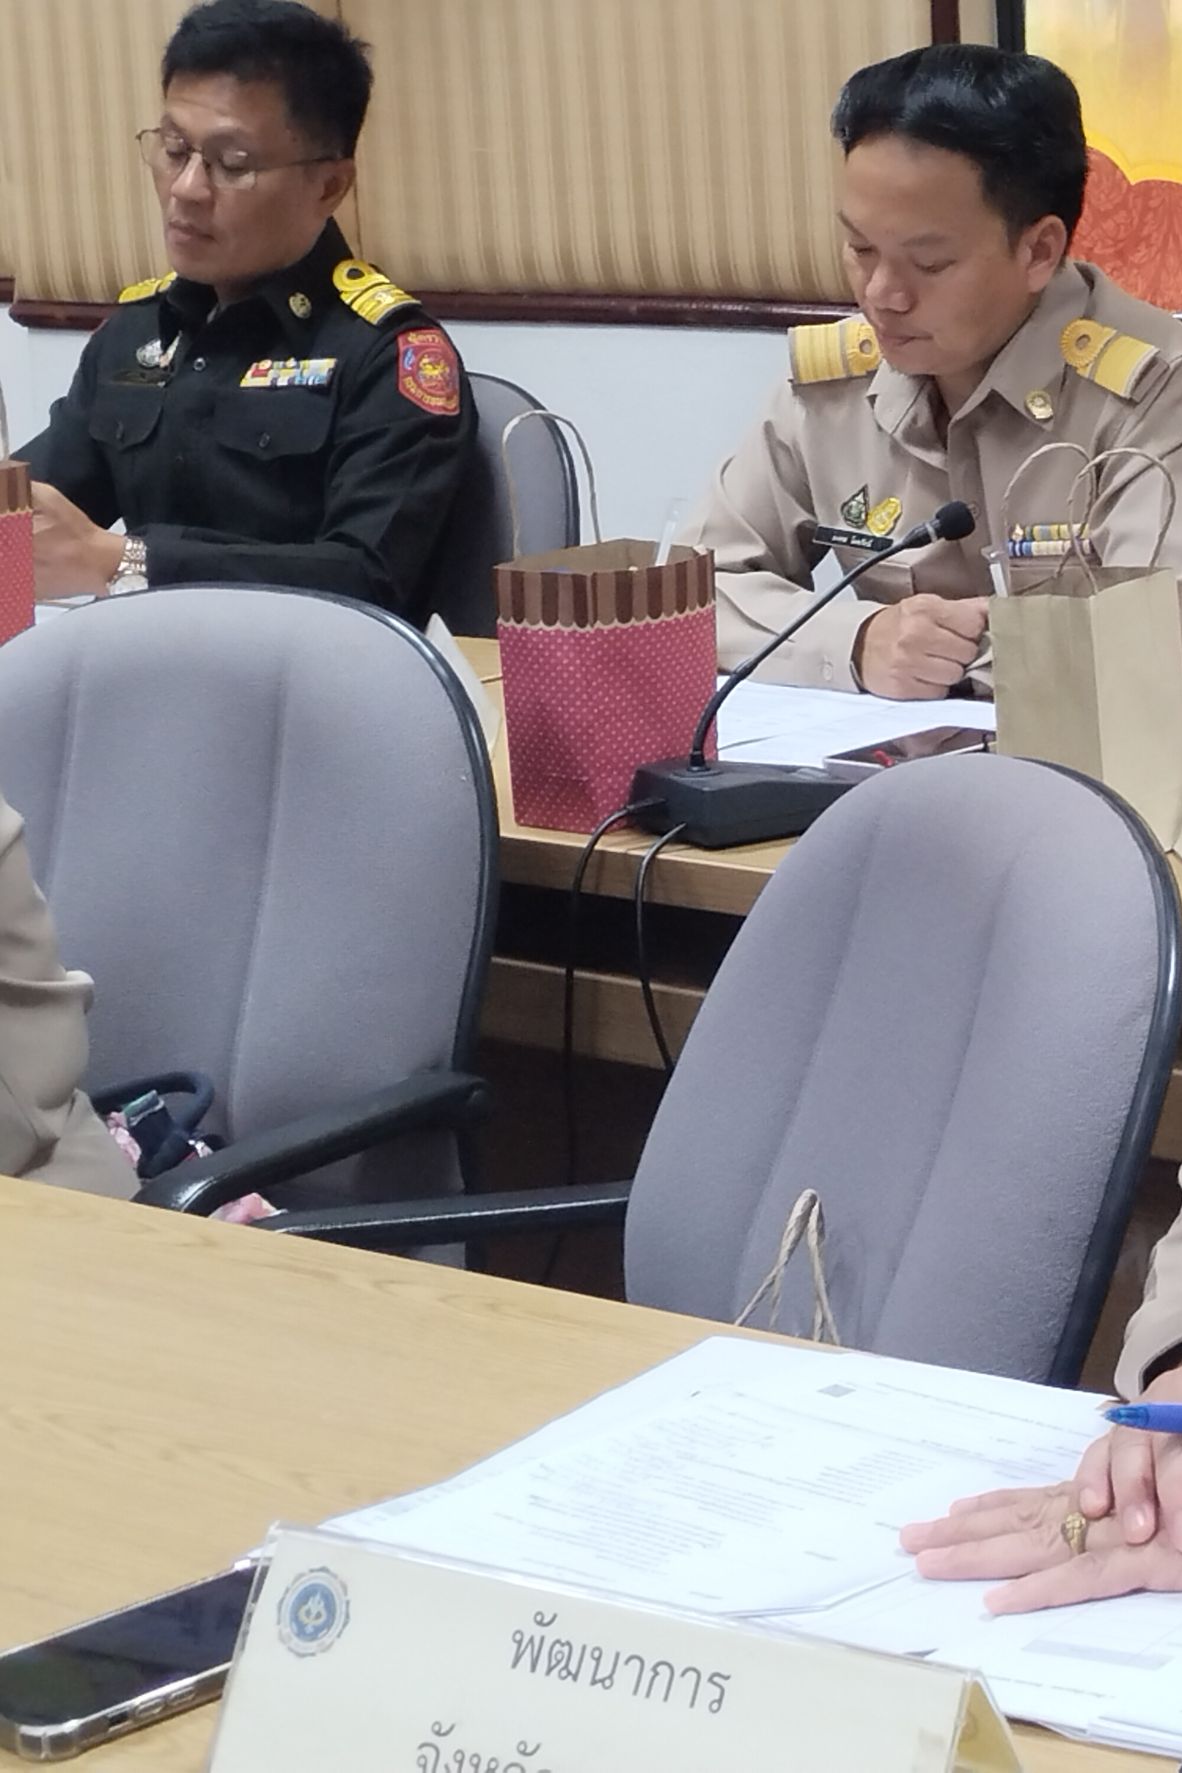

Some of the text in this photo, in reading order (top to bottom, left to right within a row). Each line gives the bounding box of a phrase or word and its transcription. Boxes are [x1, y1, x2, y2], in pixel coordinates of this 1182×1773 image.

[511, 1610, 731, 1714] พัฒนาการ
[416, 1720, 553, 1773] จังหั
